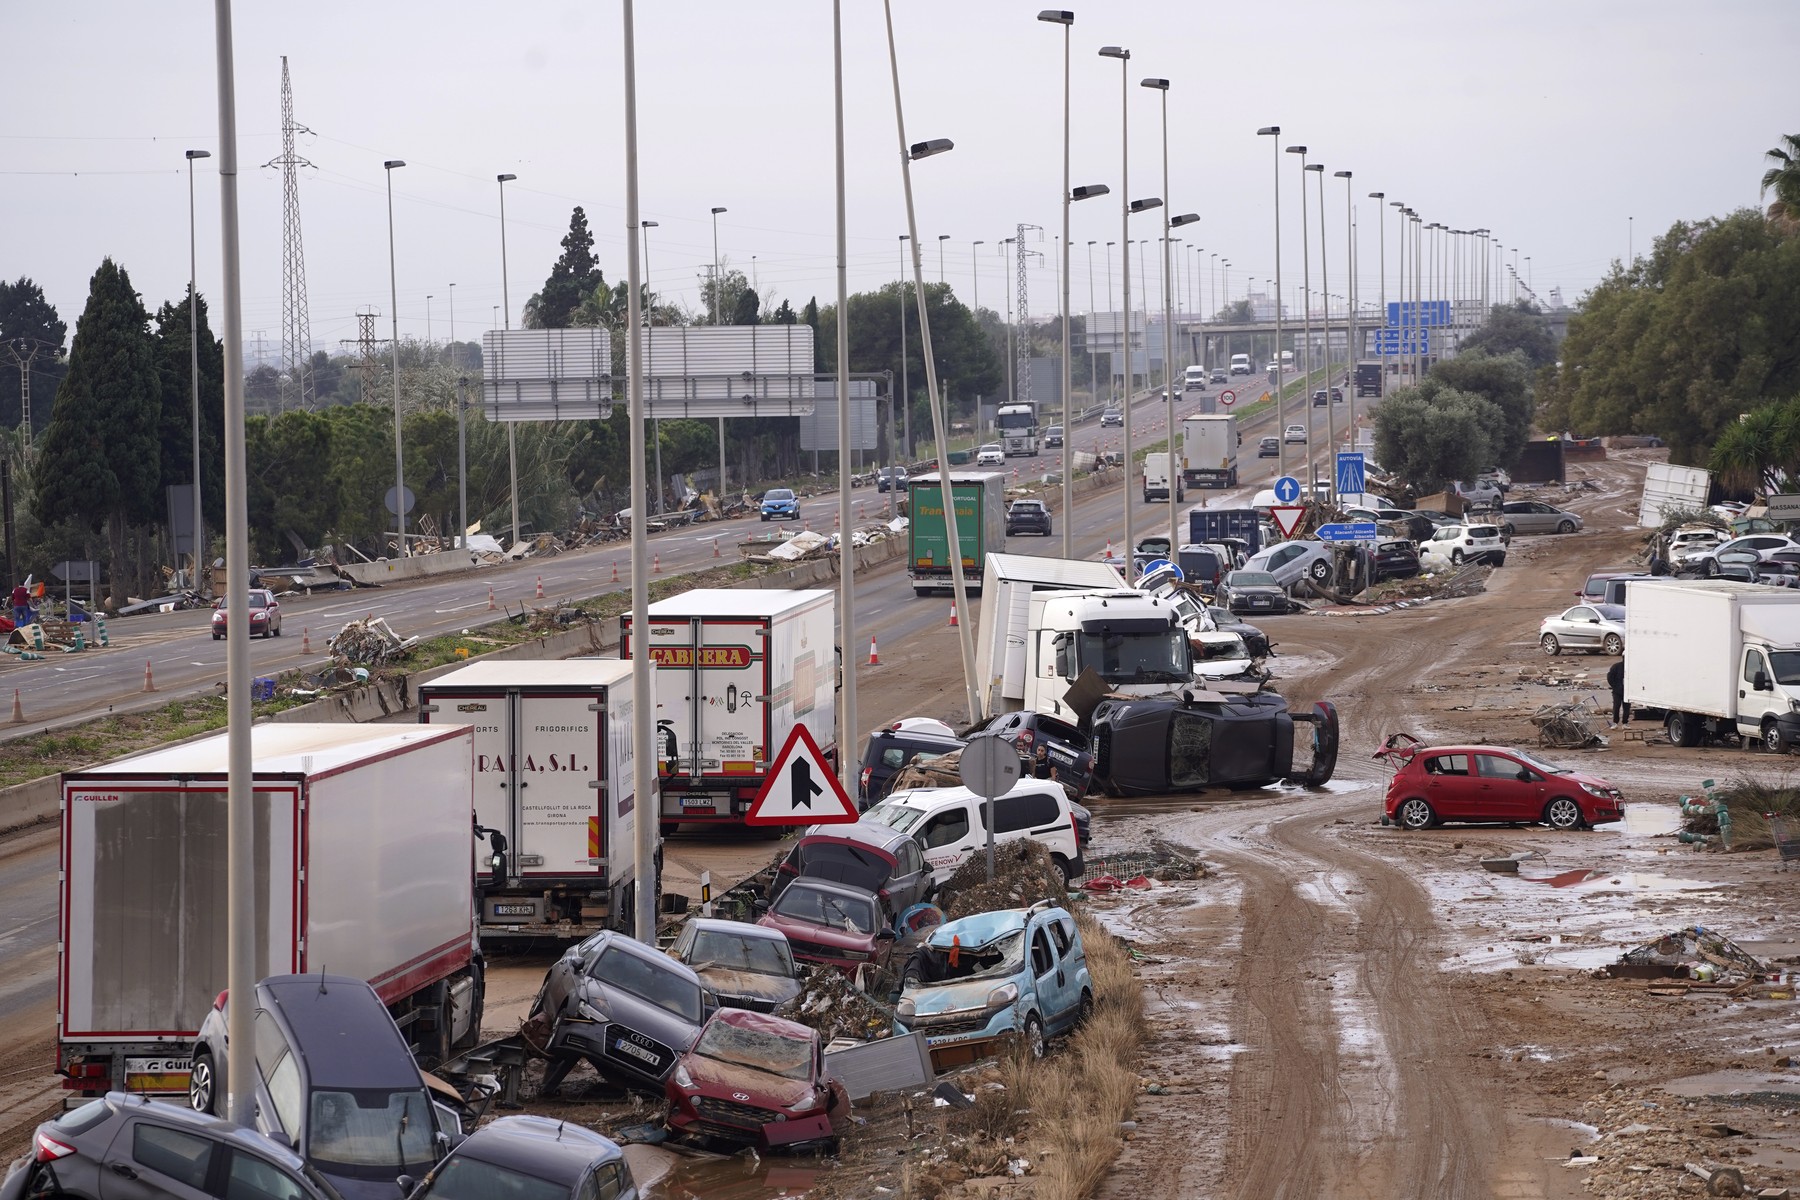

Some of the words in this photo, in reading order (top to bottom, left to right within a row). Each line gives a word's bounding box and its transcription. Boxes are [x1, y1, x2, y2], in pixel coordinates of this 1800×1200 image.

[650, 649, 744, 665] CABRERA
[535, 725, 589, 733] FRIGORIFICS
[620, 1041, 641, 1057] 2705
[165, 1060, 194, 1070] GUIL
